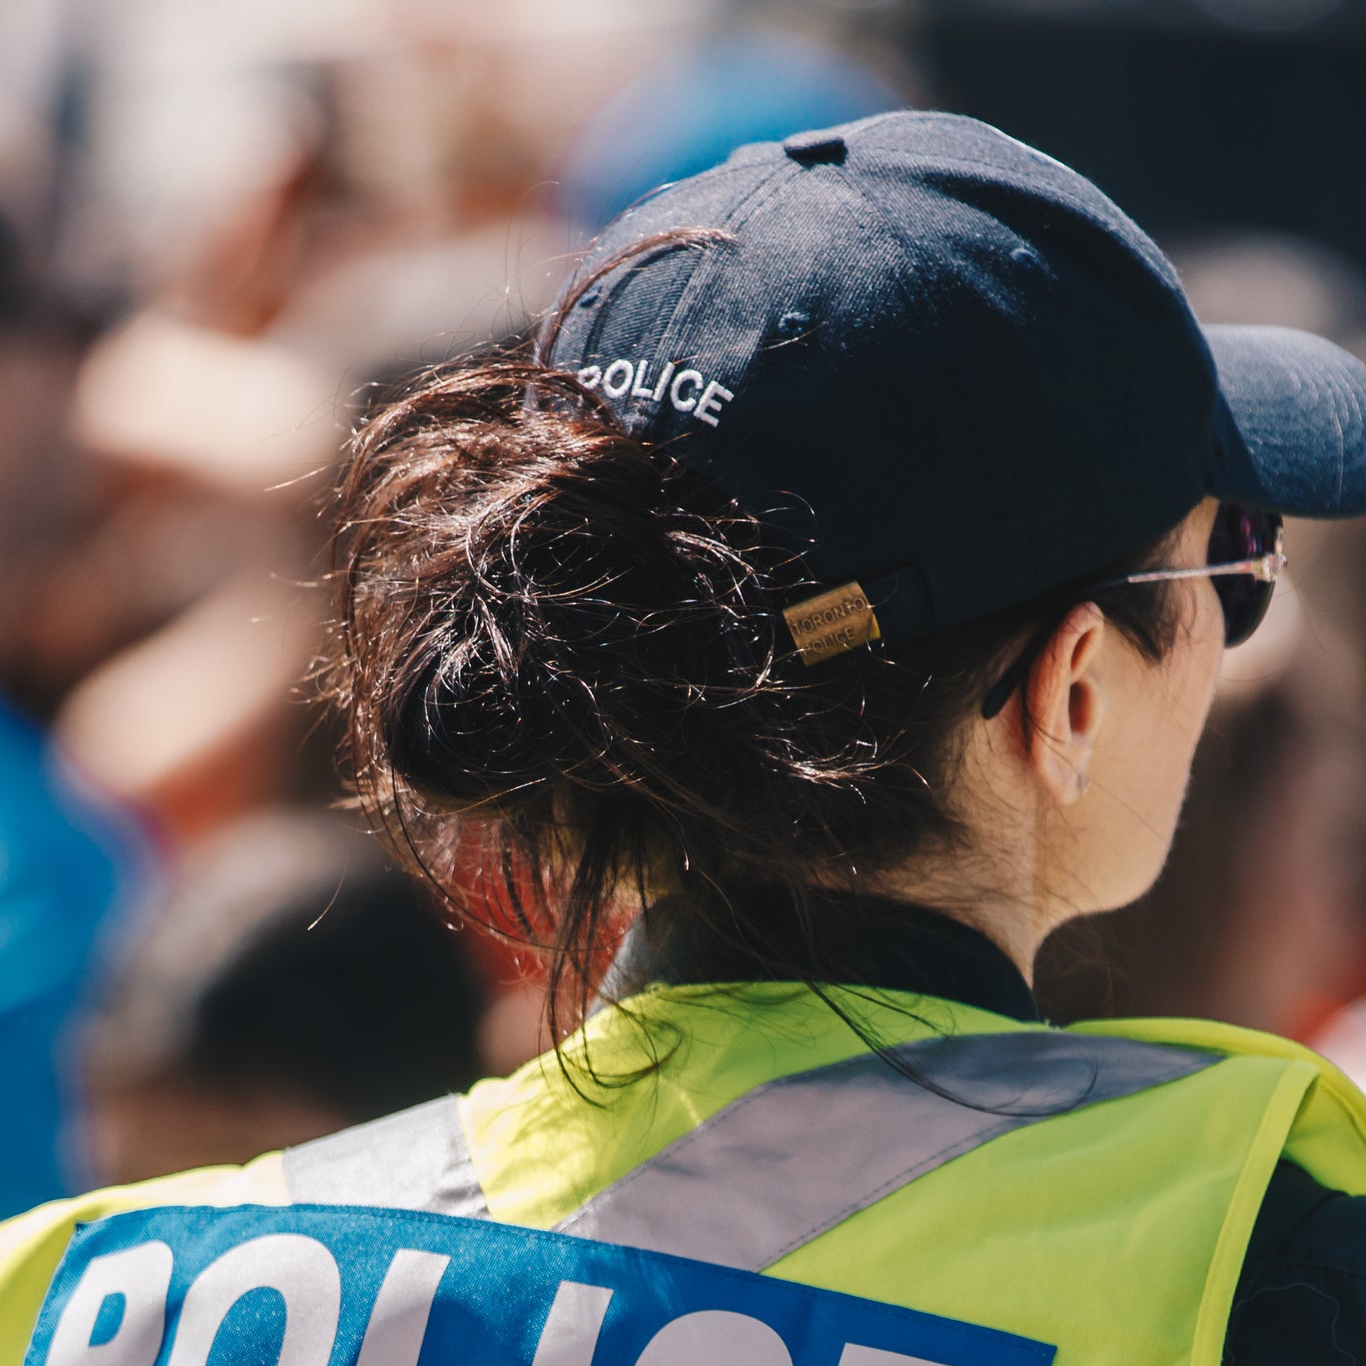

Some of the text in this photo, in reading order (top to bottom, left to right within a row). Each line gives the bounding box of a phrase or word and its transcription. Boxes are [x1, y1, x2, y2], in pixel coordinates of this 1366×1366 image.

[578, 358, 735, 428] POLICE
[789, 596, 866, 636] TORONTO
[801, 625, 857, 658] POLICE
